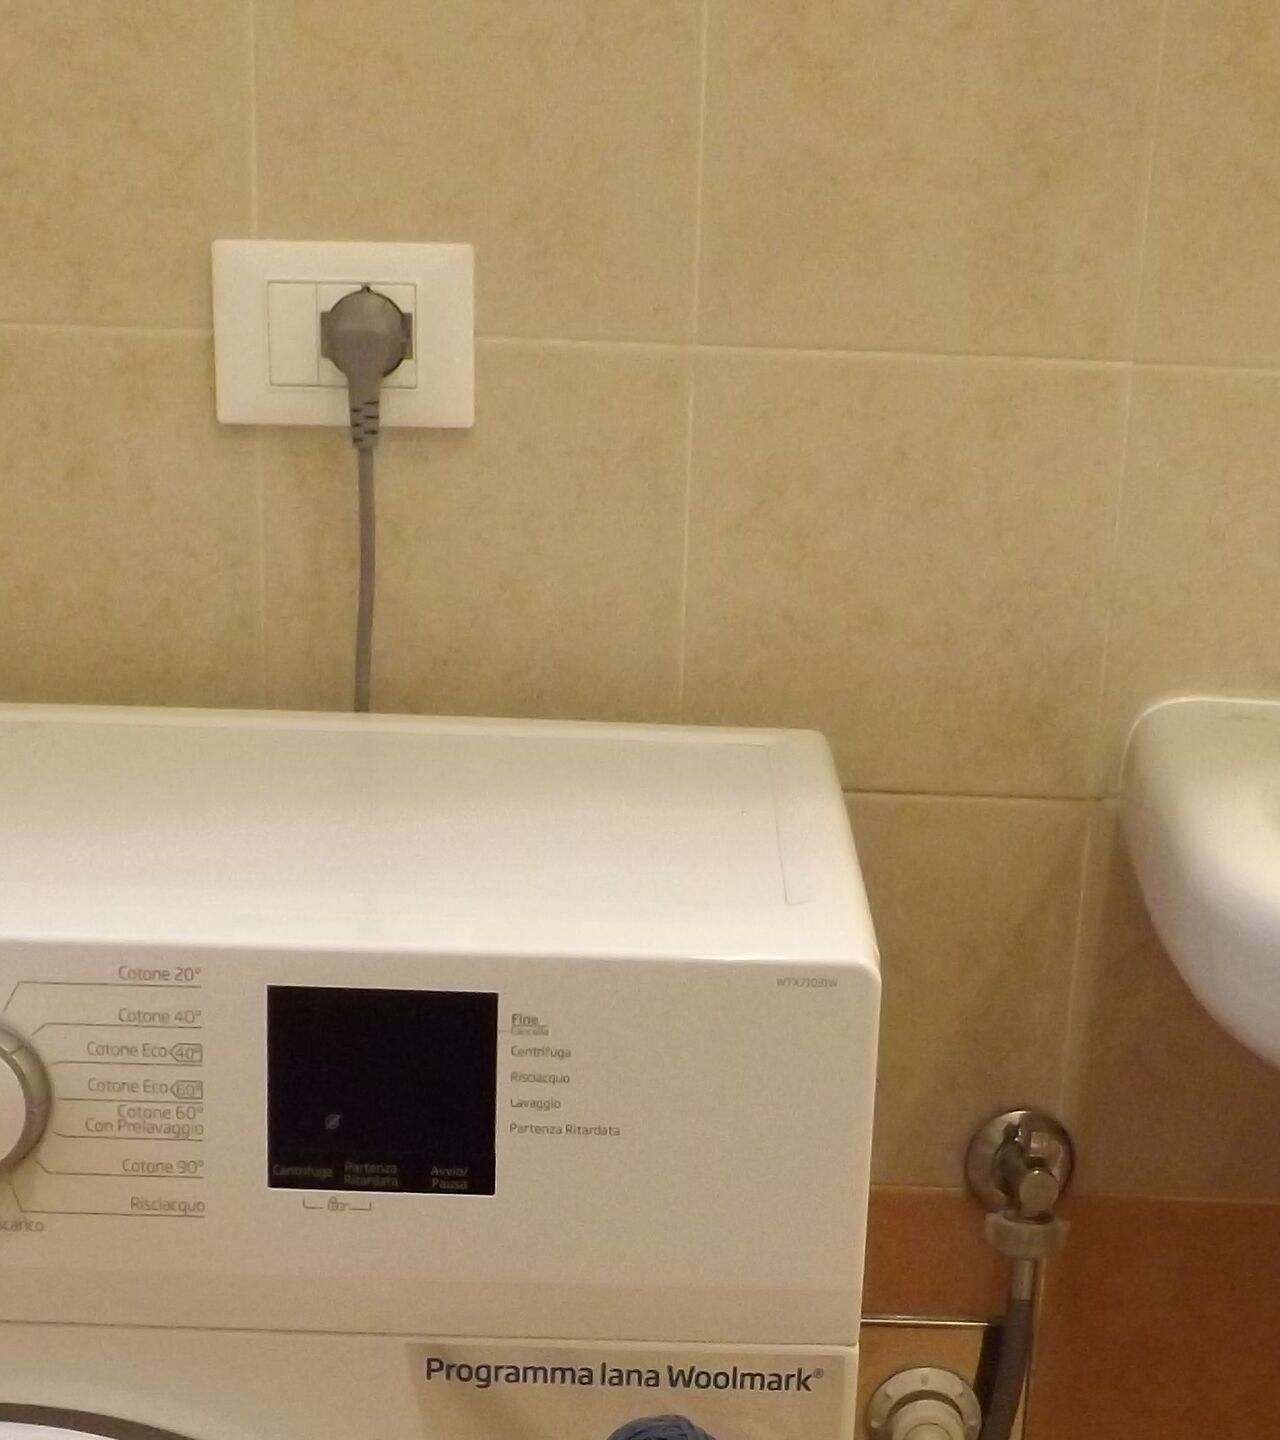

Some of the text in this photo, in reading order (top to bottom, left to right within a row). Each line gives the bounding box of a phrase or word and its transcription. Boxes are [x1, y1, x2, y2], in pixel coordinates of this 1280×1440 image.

[118, 965, 201, 981] Cotone 20°
[118, 1007, 202, 1024] Cotone 40°
[511, 1013, 539, 1025] Fine
[86, 1041, 138, 1057] Cotone
[141, 1043, 167, 1058] Eco
[510, 1045, 572, 1060] Centrifuga
[87, 1077, 139, 1093] Cotone
[143, 1079, 168, 1094] Eco
[510, 1071, 570, 1085] Risciacquo
[117, 1104, 204, 1121] Cotone 60°
[510, 1098, 561, 1112] Lavaggio
[85, 1117, 204, 1138] Con Prelavaggio
[509, 1122, 621, 1136] Partenza Ritardata
[122, 1158, 205, 1174] Cotone 90°
[130, 1196, 205, 1216] Risciacquo
[426, 1357, 593, 1388] Programma
[600, 1362, 661, 1387] lana
